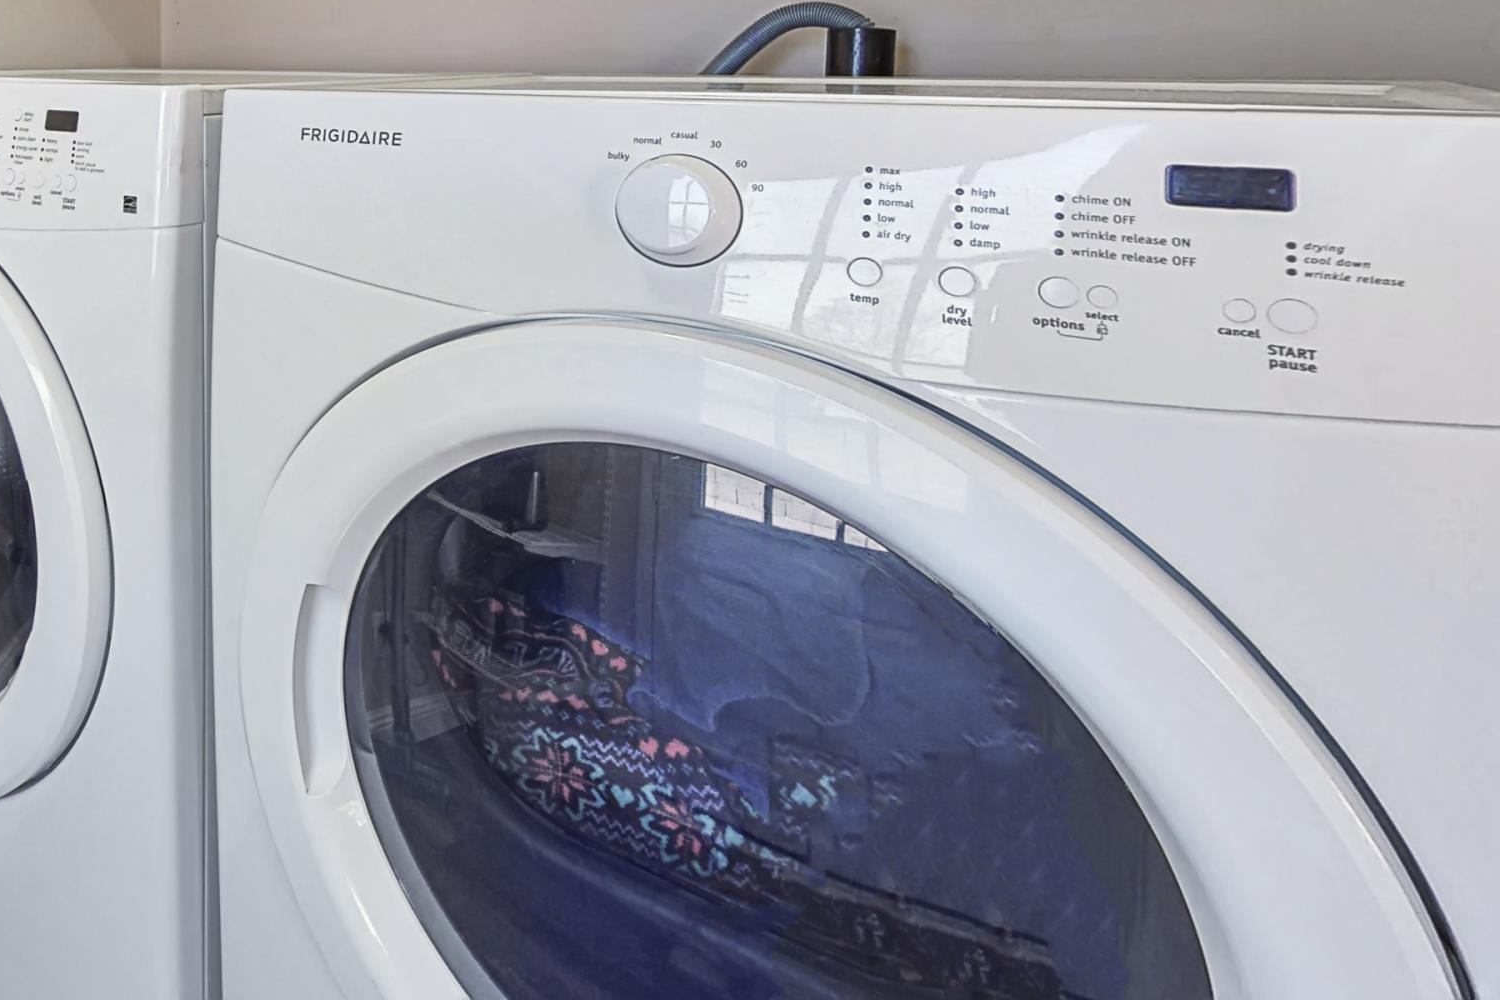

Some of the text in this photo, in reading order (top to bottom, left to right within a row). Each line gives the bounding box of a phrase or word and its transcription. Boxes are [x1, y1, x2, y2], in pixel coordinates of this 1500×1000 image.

[301, 127, 403, 147] FRIGIDAIRE
[633, 136, 662, 145] normal
[670, 131, 699, 140] casual
[709, 140, 722, 149] 30
[607, 152, 630, 162] bulky
[735, 160, 748, 169] 60
[879, 166, 901, 175] max
[751, 183, 764, 192] 90
[878, 181, 903, 192] high
[970, 188, 997, 200] high
[1071, 194, 1132, 207] chime ON
[877, 198, 915, 208] normal
[970, 205, 1011, 216] normal
[877, 213, 896, 223] low
[1071, 212, 1137, 225] chime OFF
[969, 220, 990, 231] low
[876, 229, 912, 242] air dry
[1071, 229, 1192, 248] wrinkle release ON
[969, 237, 1002, 250] damp
[1303, 242, 1346, 255] drying
[1071, 247, 1197, 267] wrinkle release OFF
[1303, 255, 1372, 269] cool down
[1304, 269, 1406, 288] wrinkle release
[850, 293, 880, 307] temp
[946, 304, 968, 317] dry
[1085, 311, 1120, 323] select
[942, 313, 973, 327] level
[1032, 316, 1086, 332] options
[1217, 326, 1261, 339] cancel
[1266, 344, 1318, 361] START
[1268, 358, 1319, 374] pause
